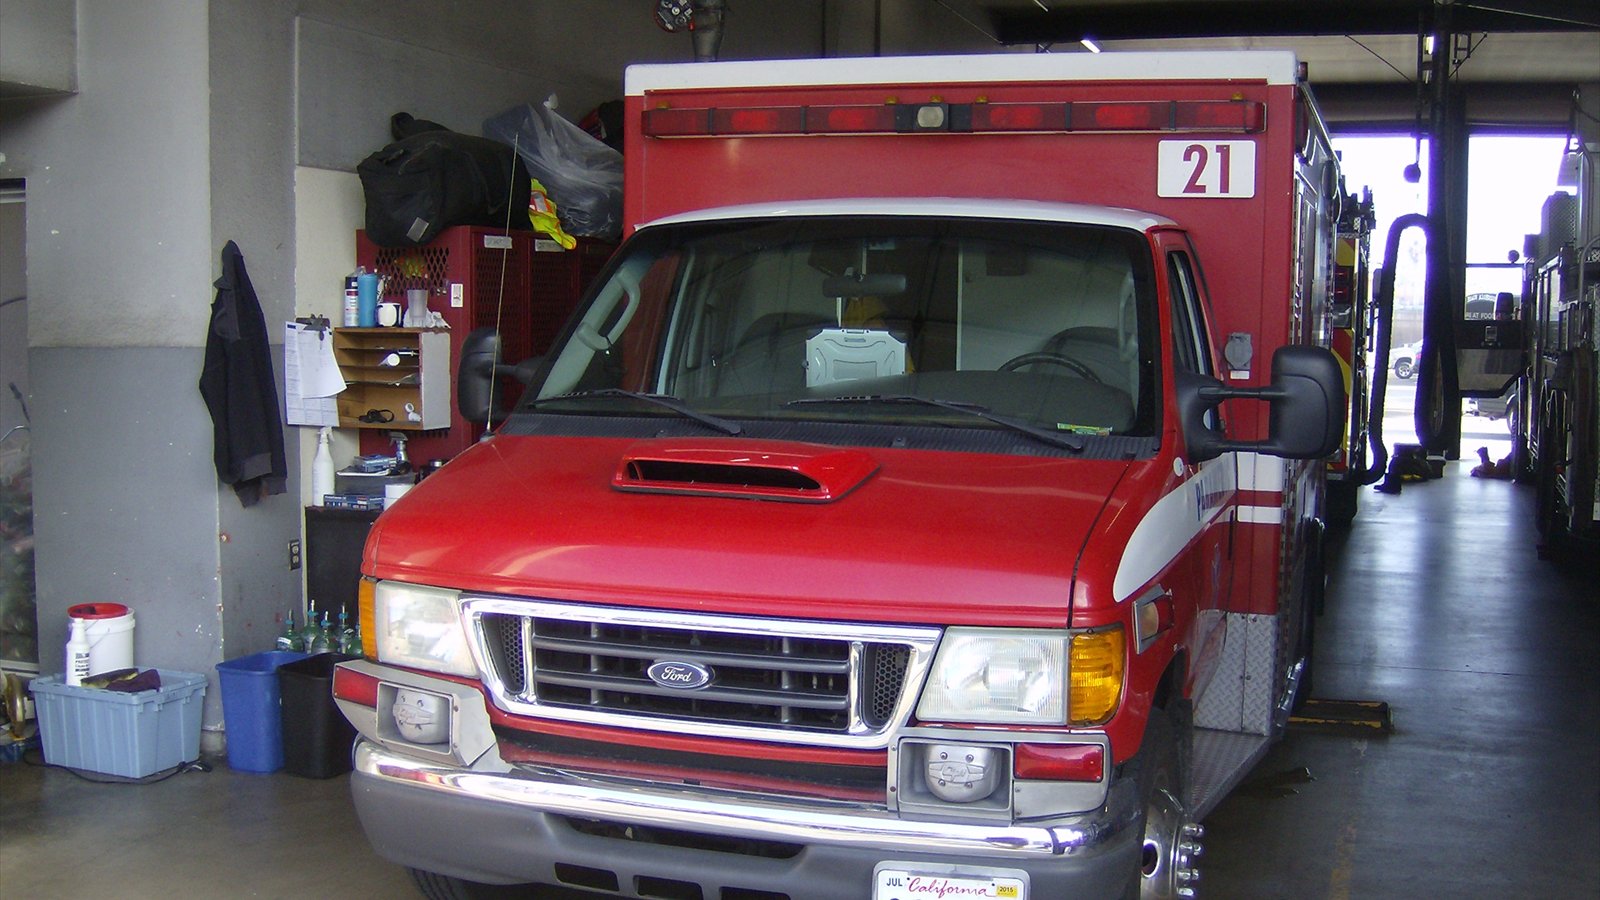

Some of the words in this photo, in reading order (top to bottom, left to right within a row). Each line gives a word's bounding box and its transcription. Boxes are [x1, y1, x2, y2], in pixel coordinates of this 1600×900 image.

[1182, 143, 1231, 194] 21
[661, 666, 693, 682] Ford
[886, 877, 903, 887] JUL
[908, 877, 993, 898] California
